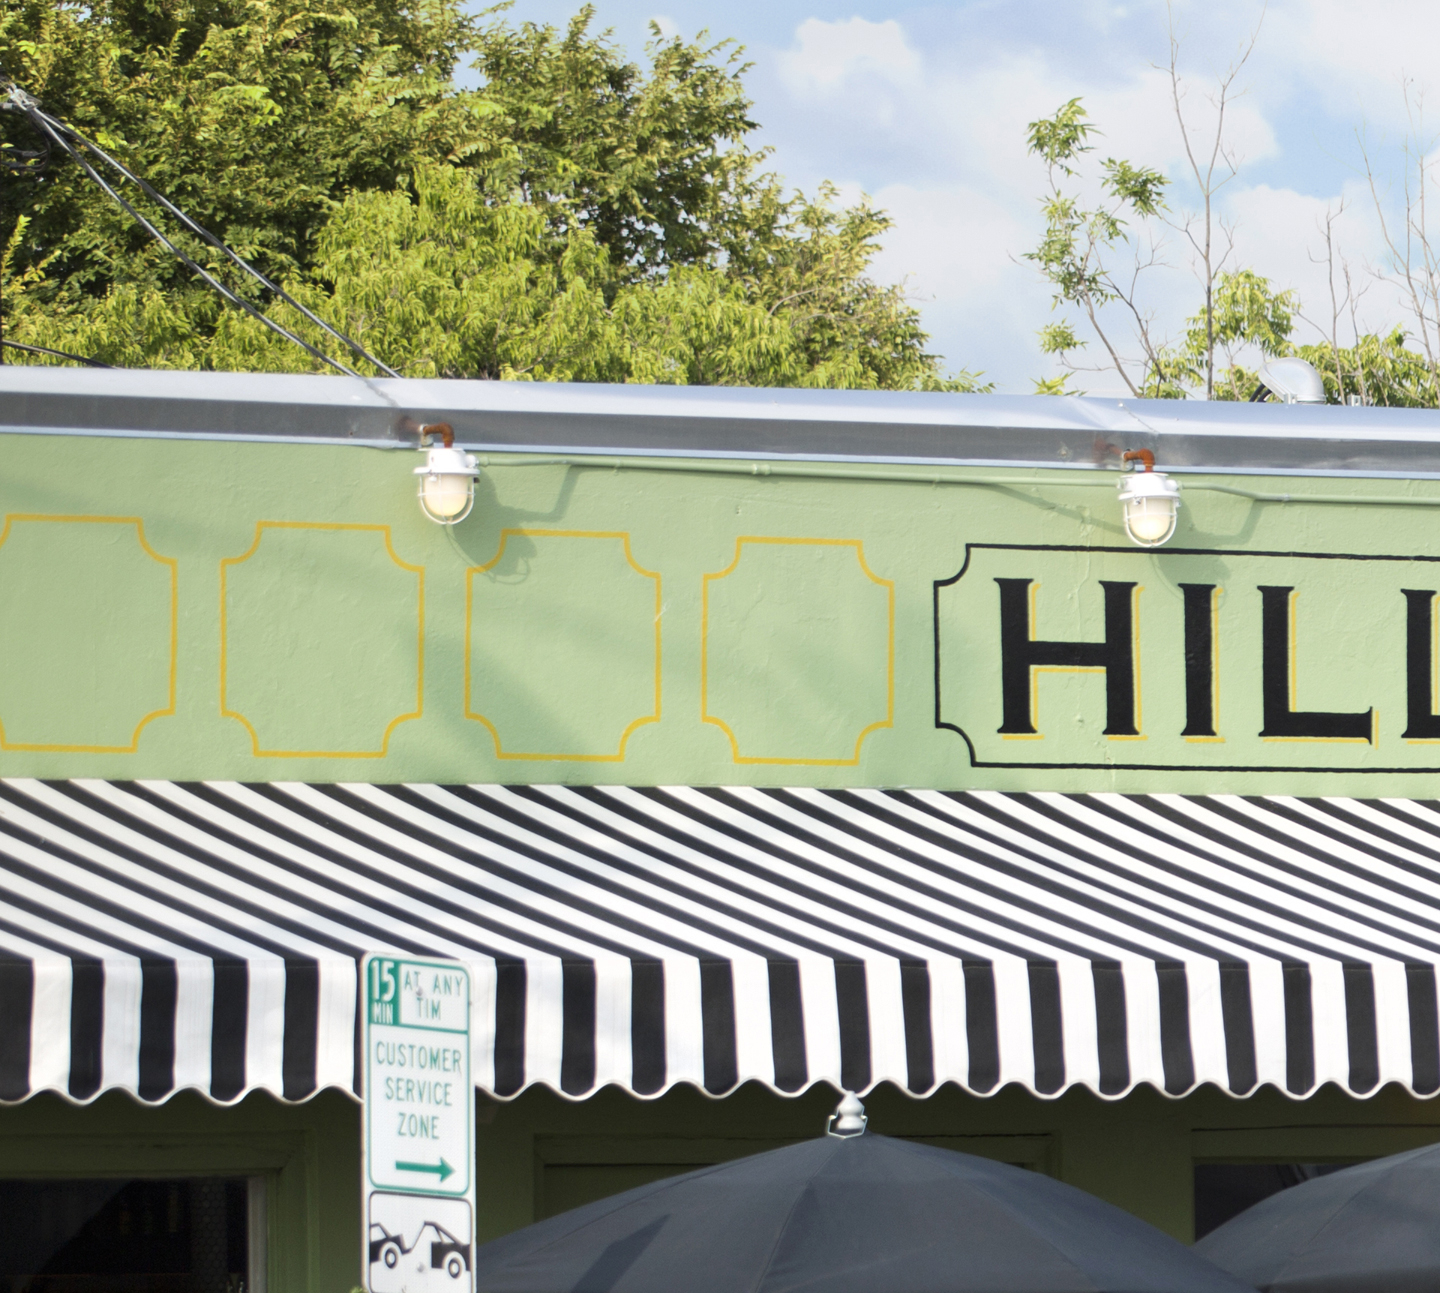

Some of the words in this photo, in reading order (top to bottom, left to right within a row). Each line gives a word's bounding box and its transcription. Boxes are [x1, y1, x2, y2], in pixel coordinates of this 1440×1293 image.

[371, 960, 396, 1003] 15
[404, 970, 421, 991] AT
[433, 973, 463, 997] ANY
[373, 1001, 394, 1025] MIN
[376, 1041, 462, 1073] CUSTOMER
[385, 1076, 453, 1107] SERVICE
[398, 1111, 440, 1140] ZONE
